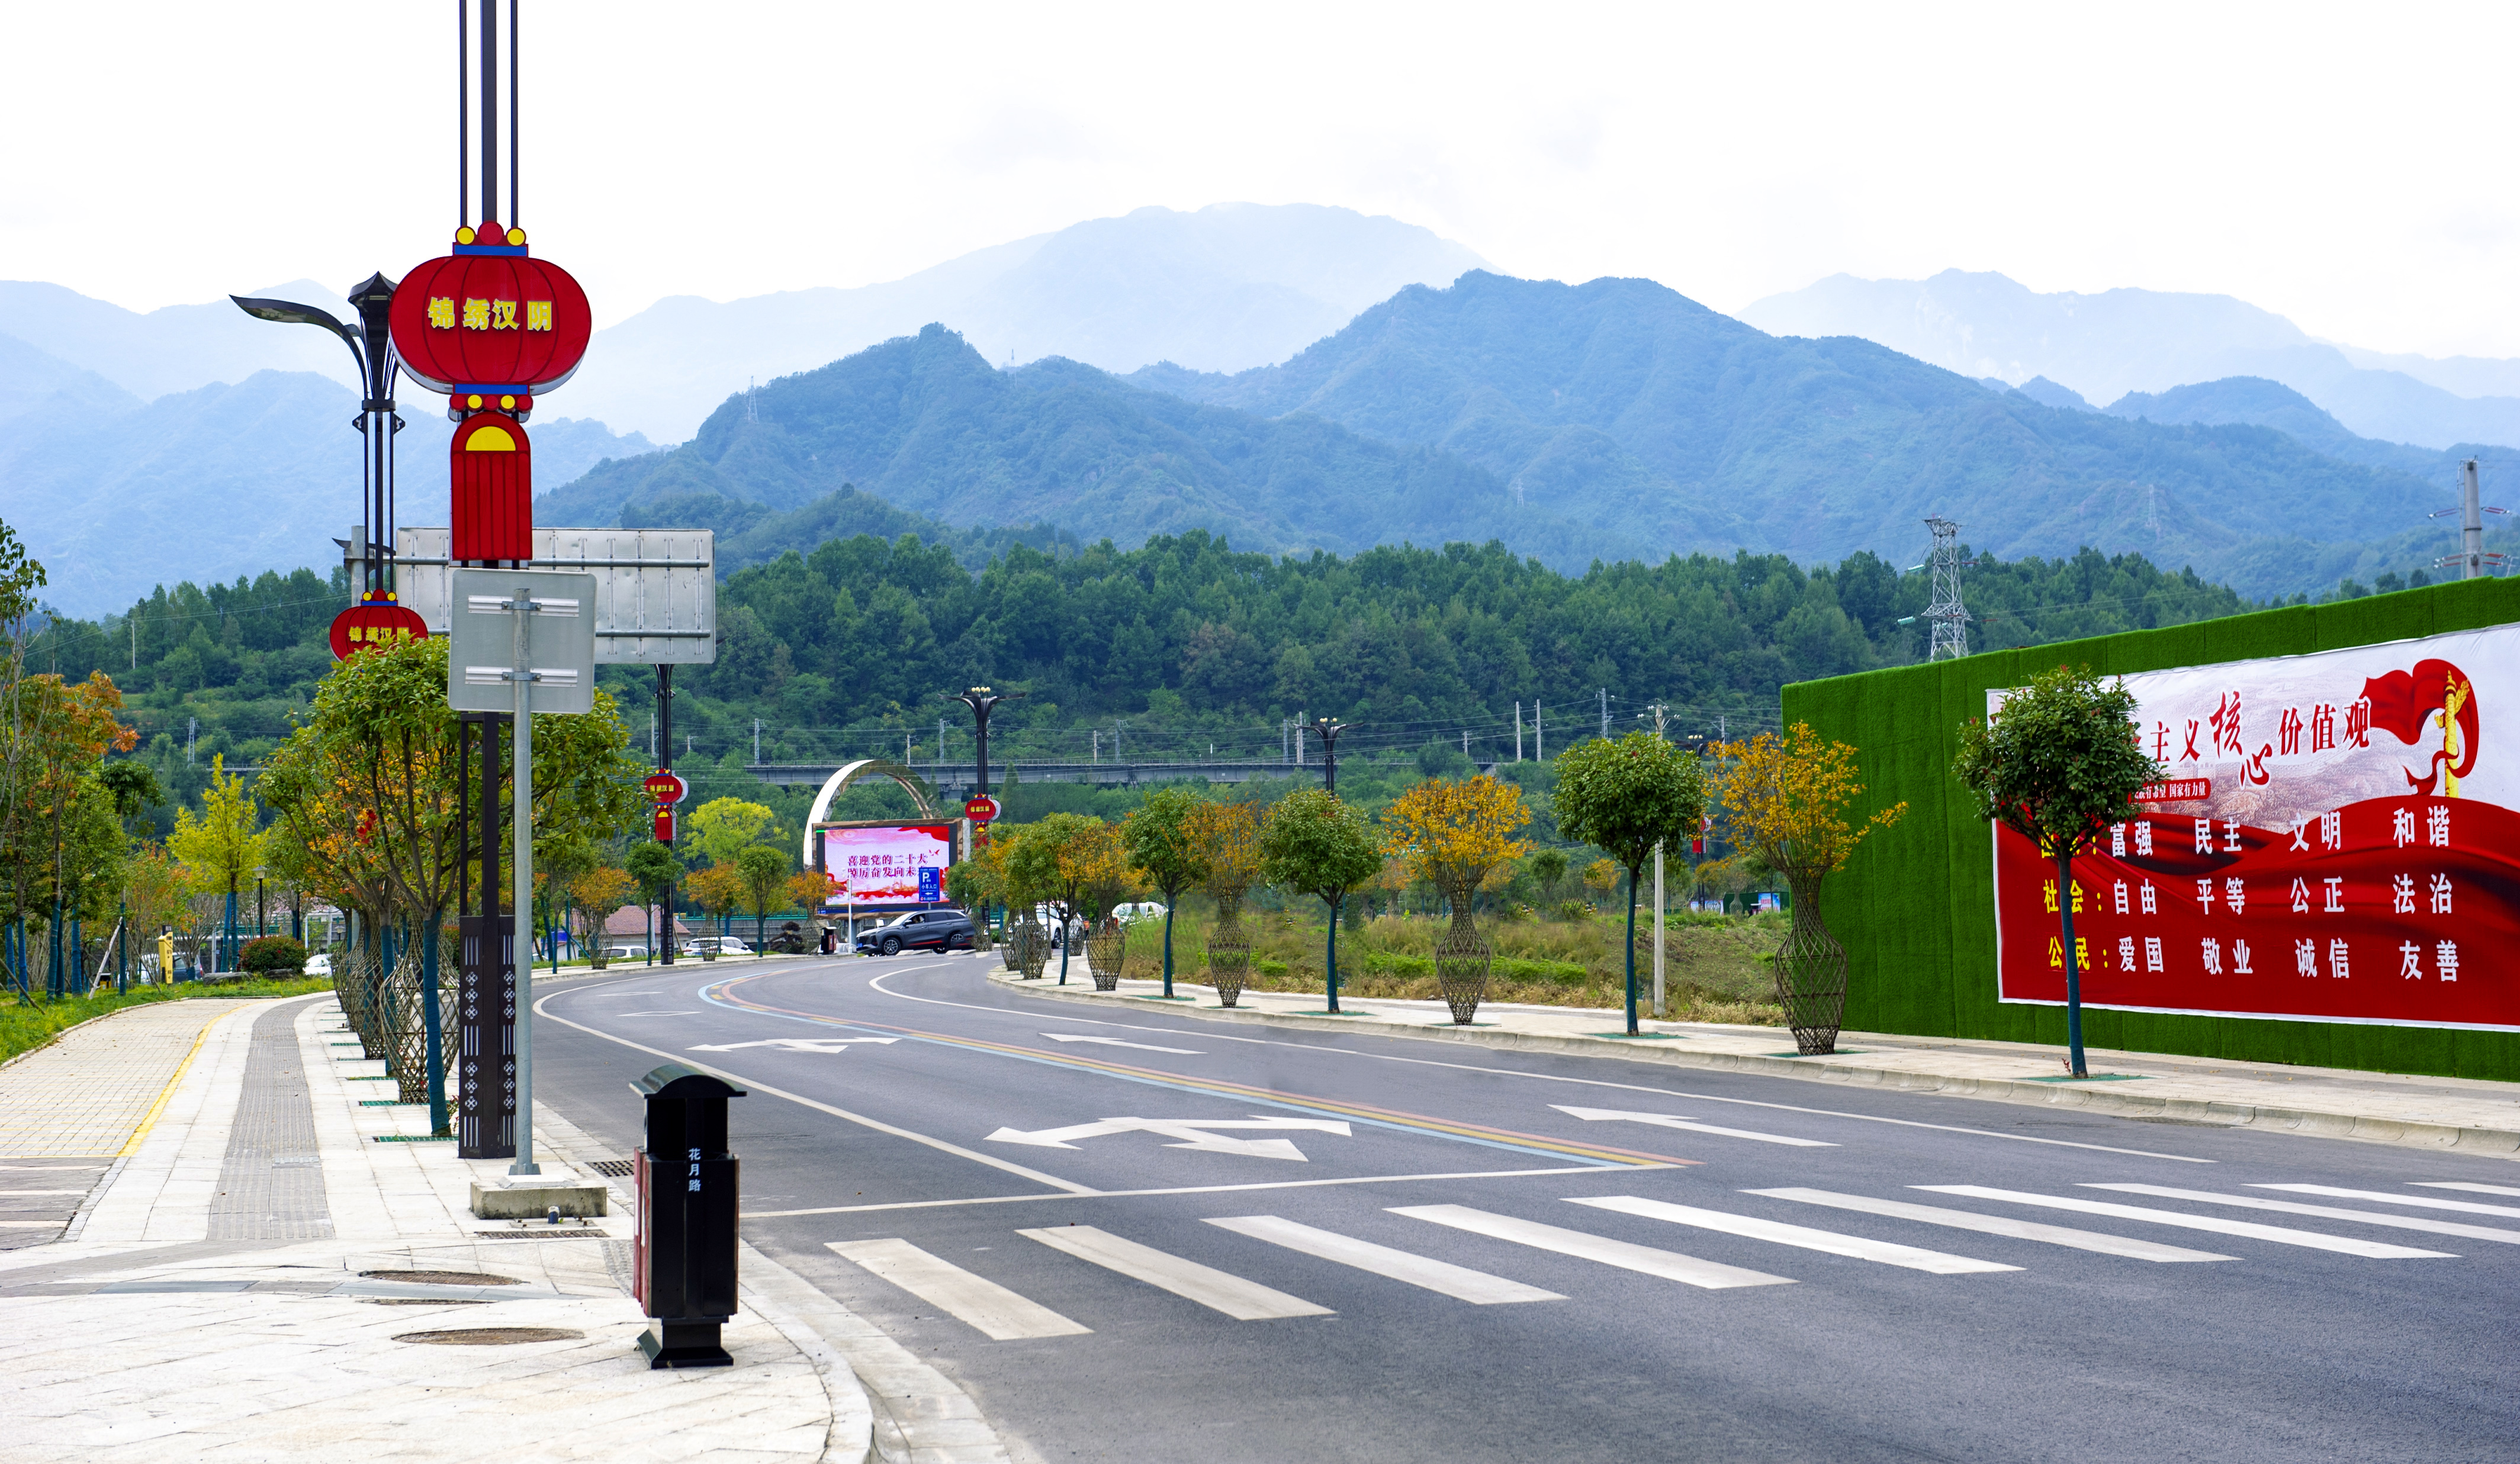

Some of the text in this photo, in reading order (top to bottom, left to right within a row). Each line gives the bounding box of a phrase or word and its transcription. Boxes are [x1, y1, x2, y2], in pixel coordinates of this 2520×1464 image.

[427, 296, 552, 332] 锦绣汉阴
[348, 626, 409, 642] 锦绣汉阴
[2132, 691, 2369, 786] 主义核心价值观
[2169, 781, 2206, 798] 国家有力量
[2194, 817, 2242, 854] 民主
[2289, 811, 2341, 852] 文明
[2393, 805, 2450, 848] 和谐
[848, 853, 928, 866] 喜迎党的二十大
[848, 866, 925, 879] 踔厉奋发向未
[922, 872, 930, 882] P
[2196, 877, 2245, 915] 平等
[2290, 876, 2345, 914] 公正
[2393, 873, 2452, 914] 法治
[2201, 938, 2253, 975] 敬业
[2295, 938, 2349, 978] 诚信
[2399, 939, 2460, 982] 友善
[689, 1148, 701, 1192] 花月路
